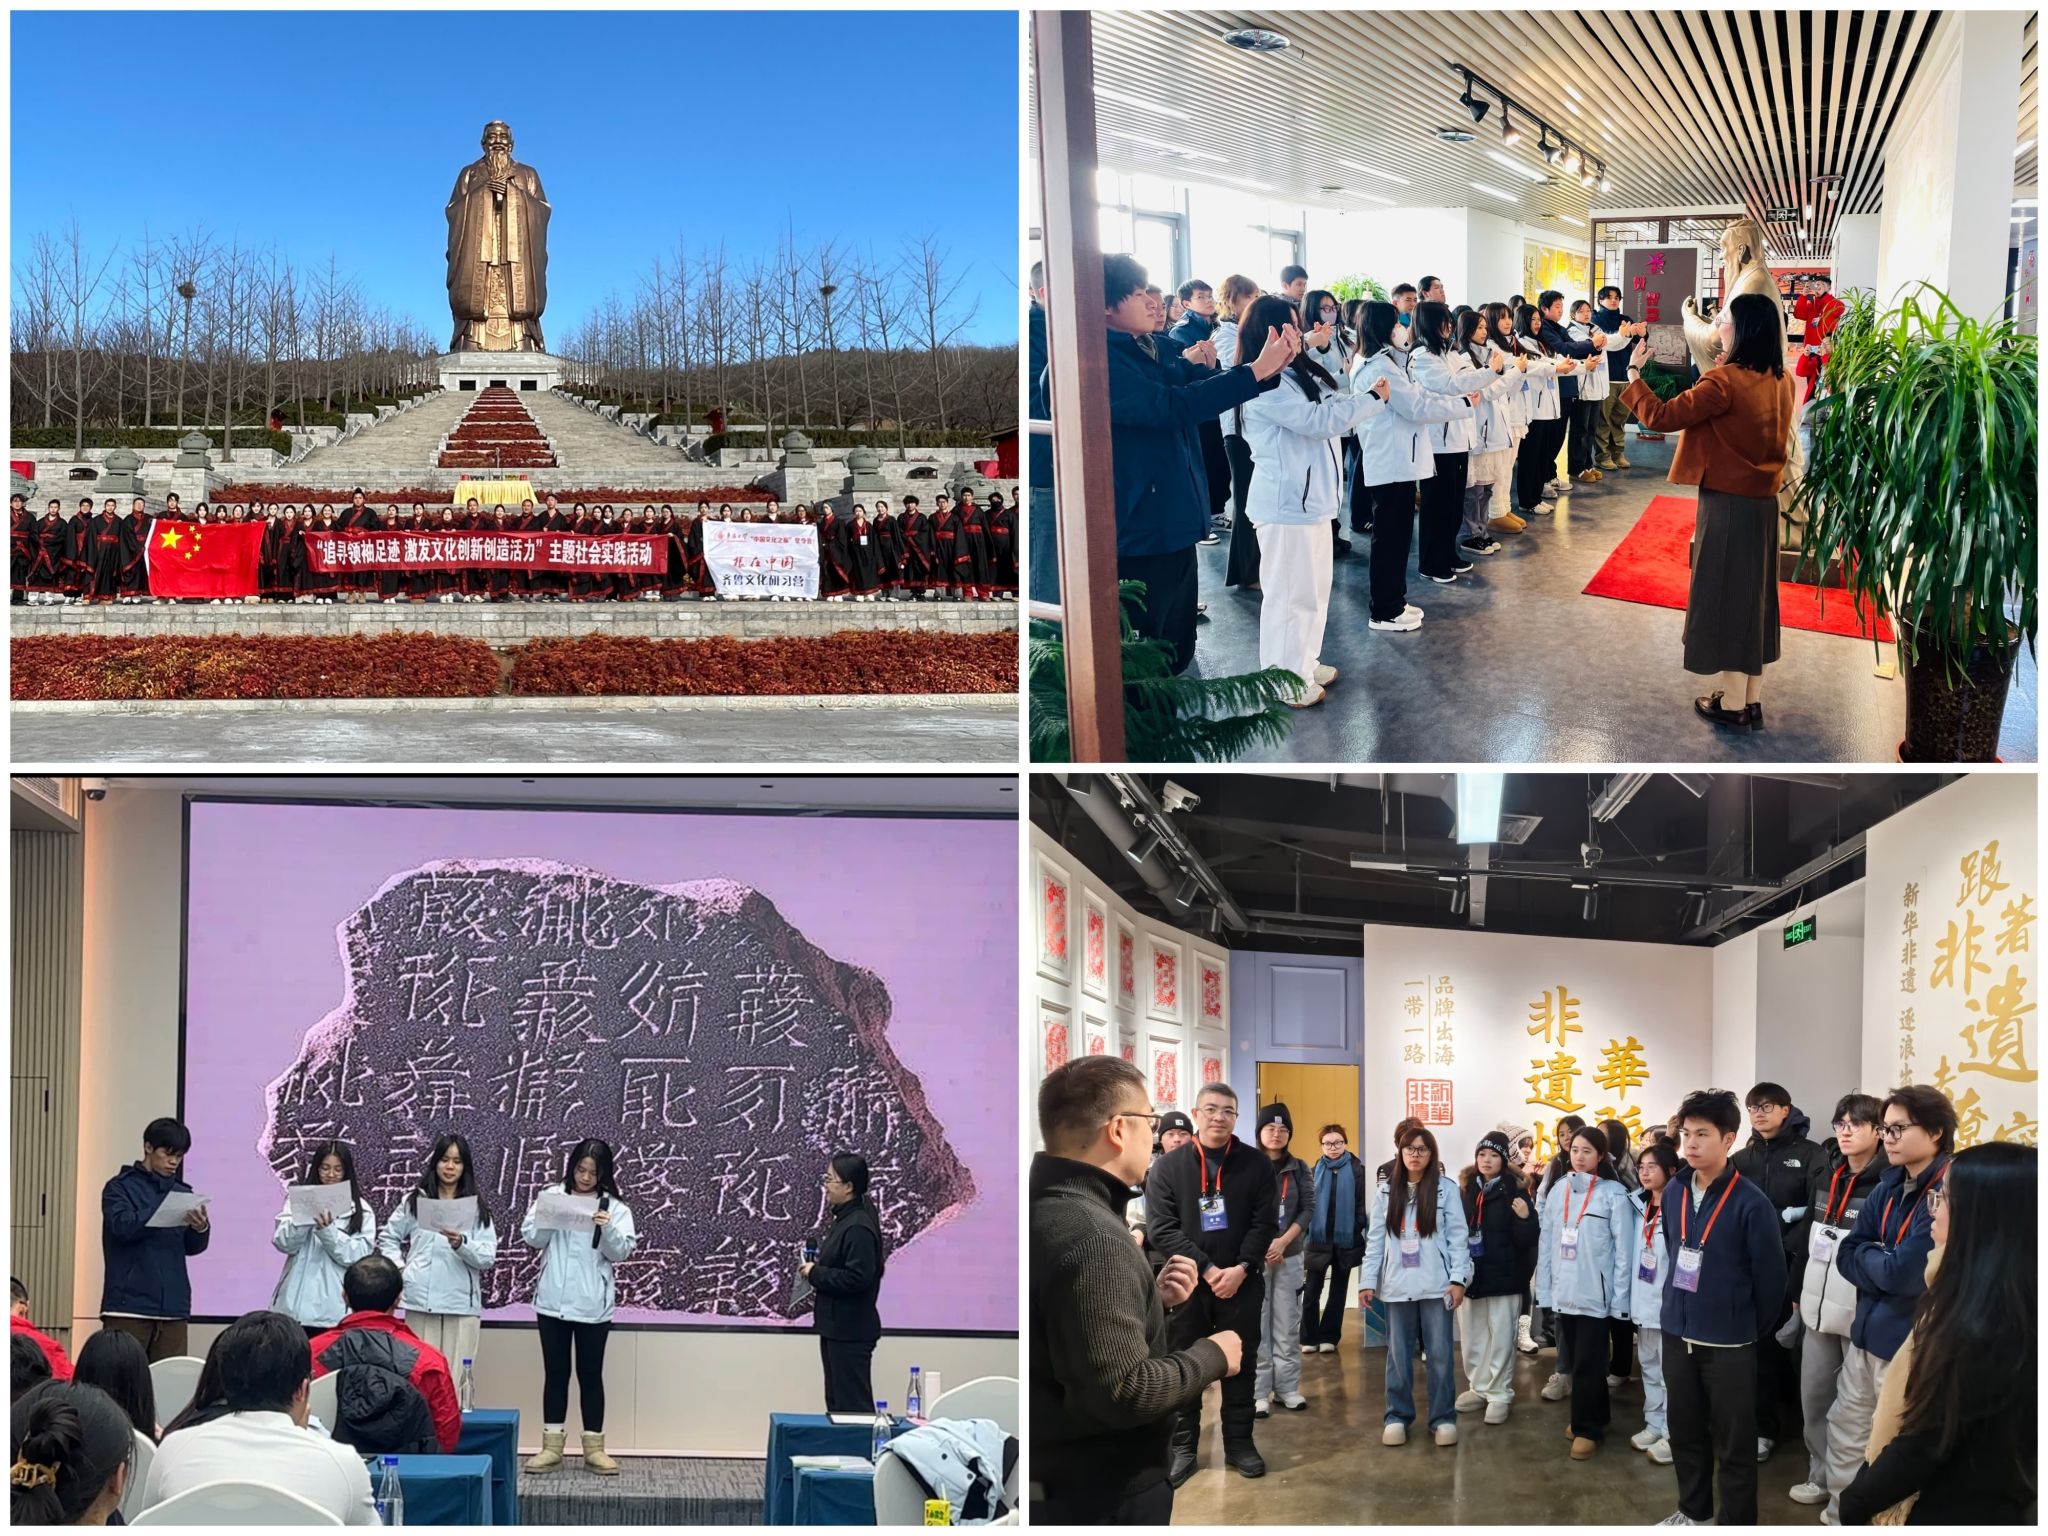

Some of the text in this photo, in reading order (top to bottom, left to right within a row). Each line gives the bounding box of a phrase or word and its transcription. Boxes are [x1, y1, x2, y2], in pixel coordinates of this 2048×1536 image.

[316, 537, 653, 566] “追寻领袖足迹 激发文化创新创造活力” 主题社会实践活动
[722, 574, 804, 587] 齐鲁文化研习营
[1434, 975, 1456, 1067] 品牌出海
